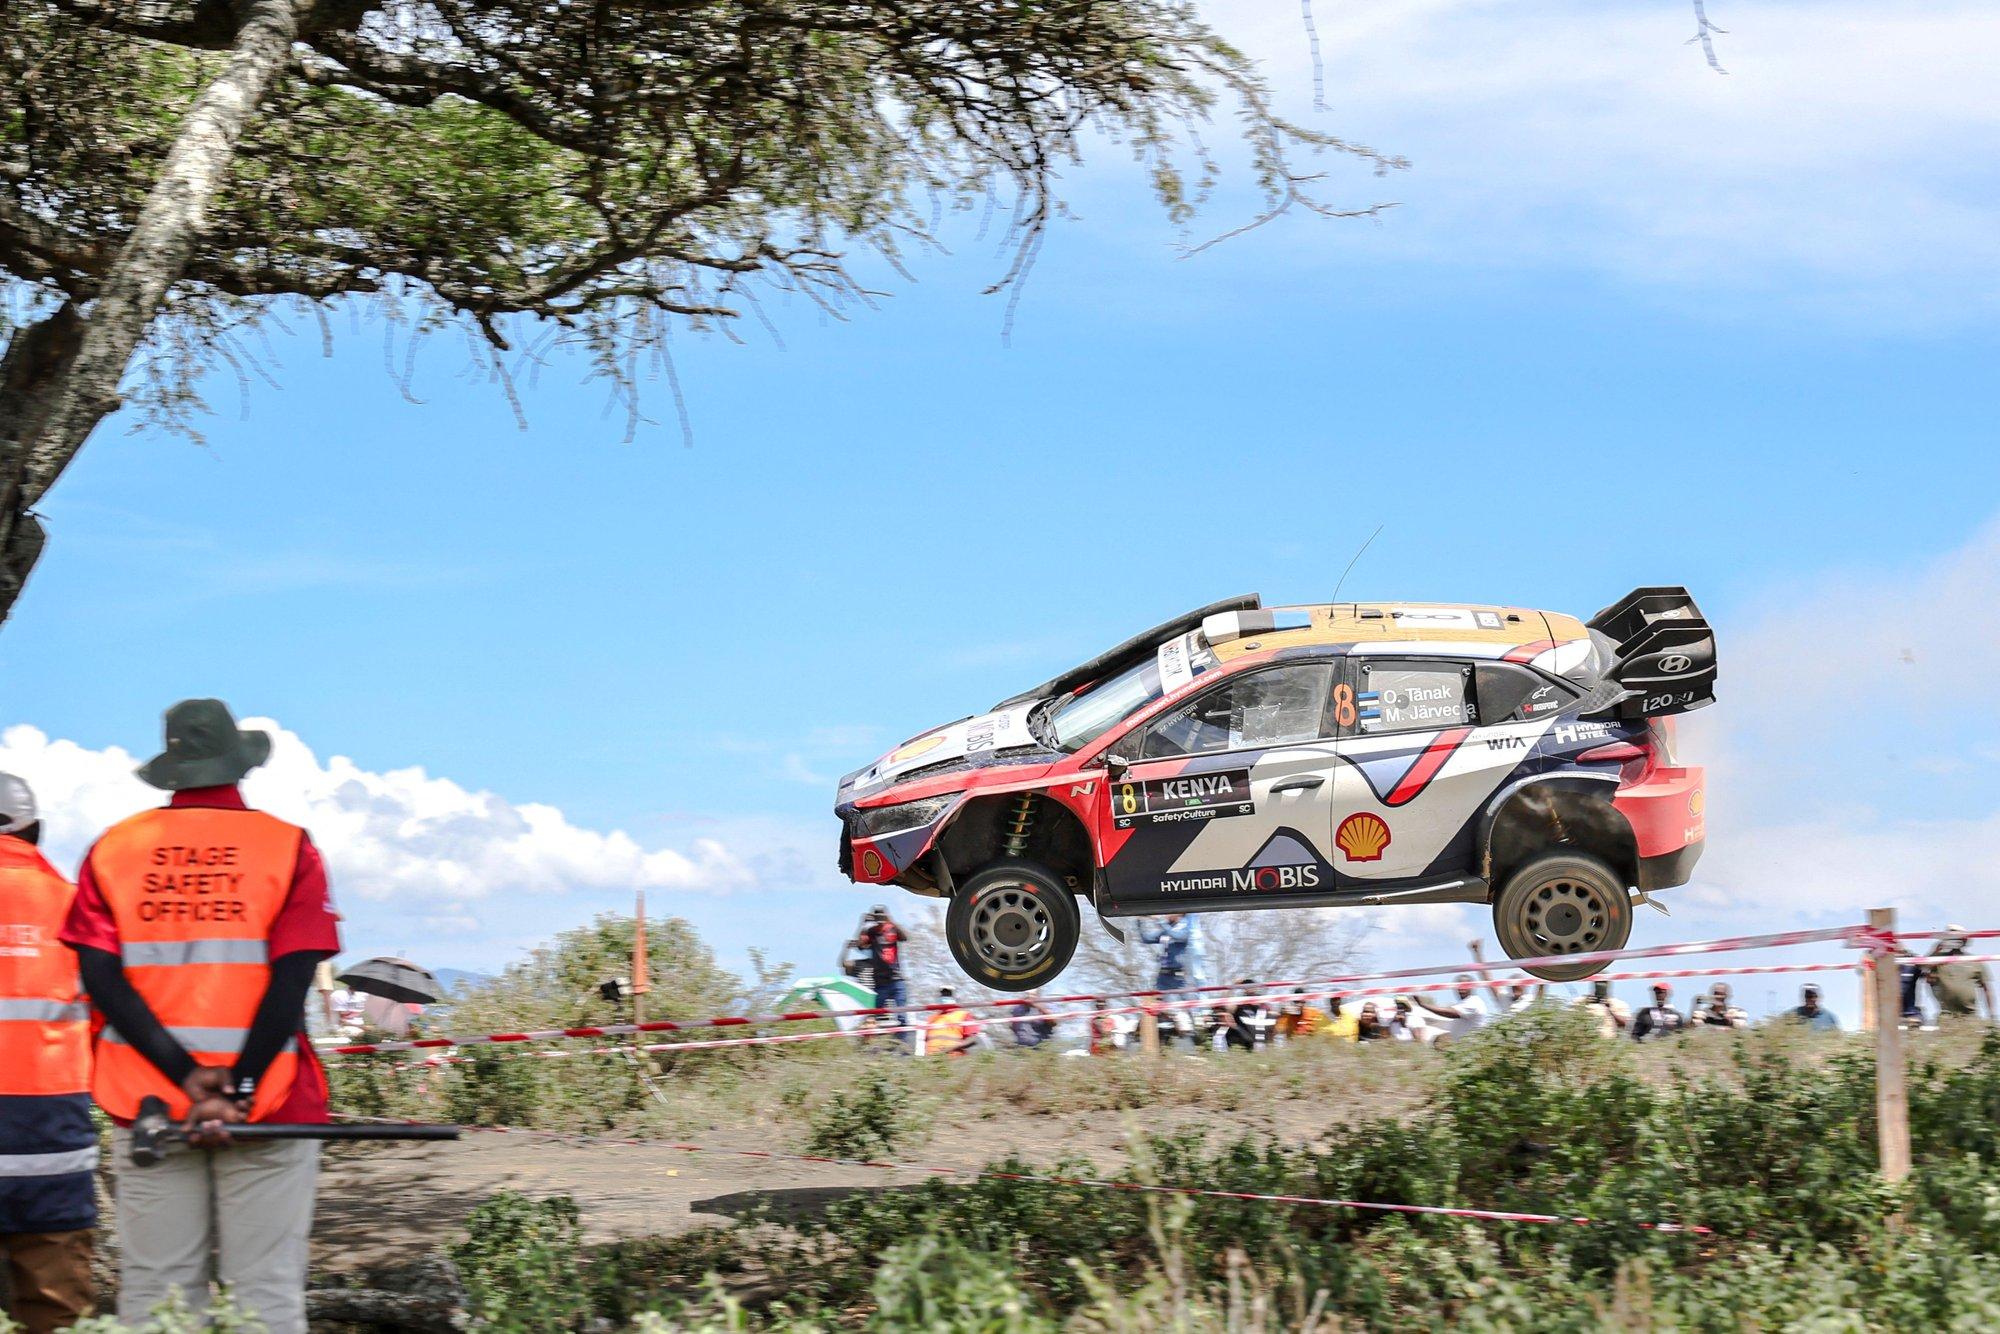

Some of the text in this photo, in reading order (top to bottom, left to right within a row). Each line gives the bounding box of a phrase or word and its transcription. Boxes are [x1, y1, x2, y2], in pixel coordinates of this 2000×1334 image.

[1126, 671, 1223, 727] motorsport.hyundai.com
[1384, 685, 1452, 704] O. Tänak
[1168, 703, 1199, 727] HYUNDAI
[1333, 683, 1358, 727] 8
[1386, 707, 1405, 723] M.
[1576, 721, 1622, 732] HYUNDAI
[1578, 730, 1612, 741] STEEL
[1487, 737, 1526, 750] WIA
[1163, 775, 1233, 801] KENYA
[1122, 784, 1137, 814] 8
[1239, 804, 1252, 814] SC
[1119, 818, 1131, 828] SC
[1152, 808, 1217, 823] SafetyCulture
[152, 846, 240, 866] STAGE
[143, 873, 245, 894] SAFETY
[1161, 865, 1320, 893] HYUNDAI MOBIS
[137, 901, 248, 922] OFFICER
